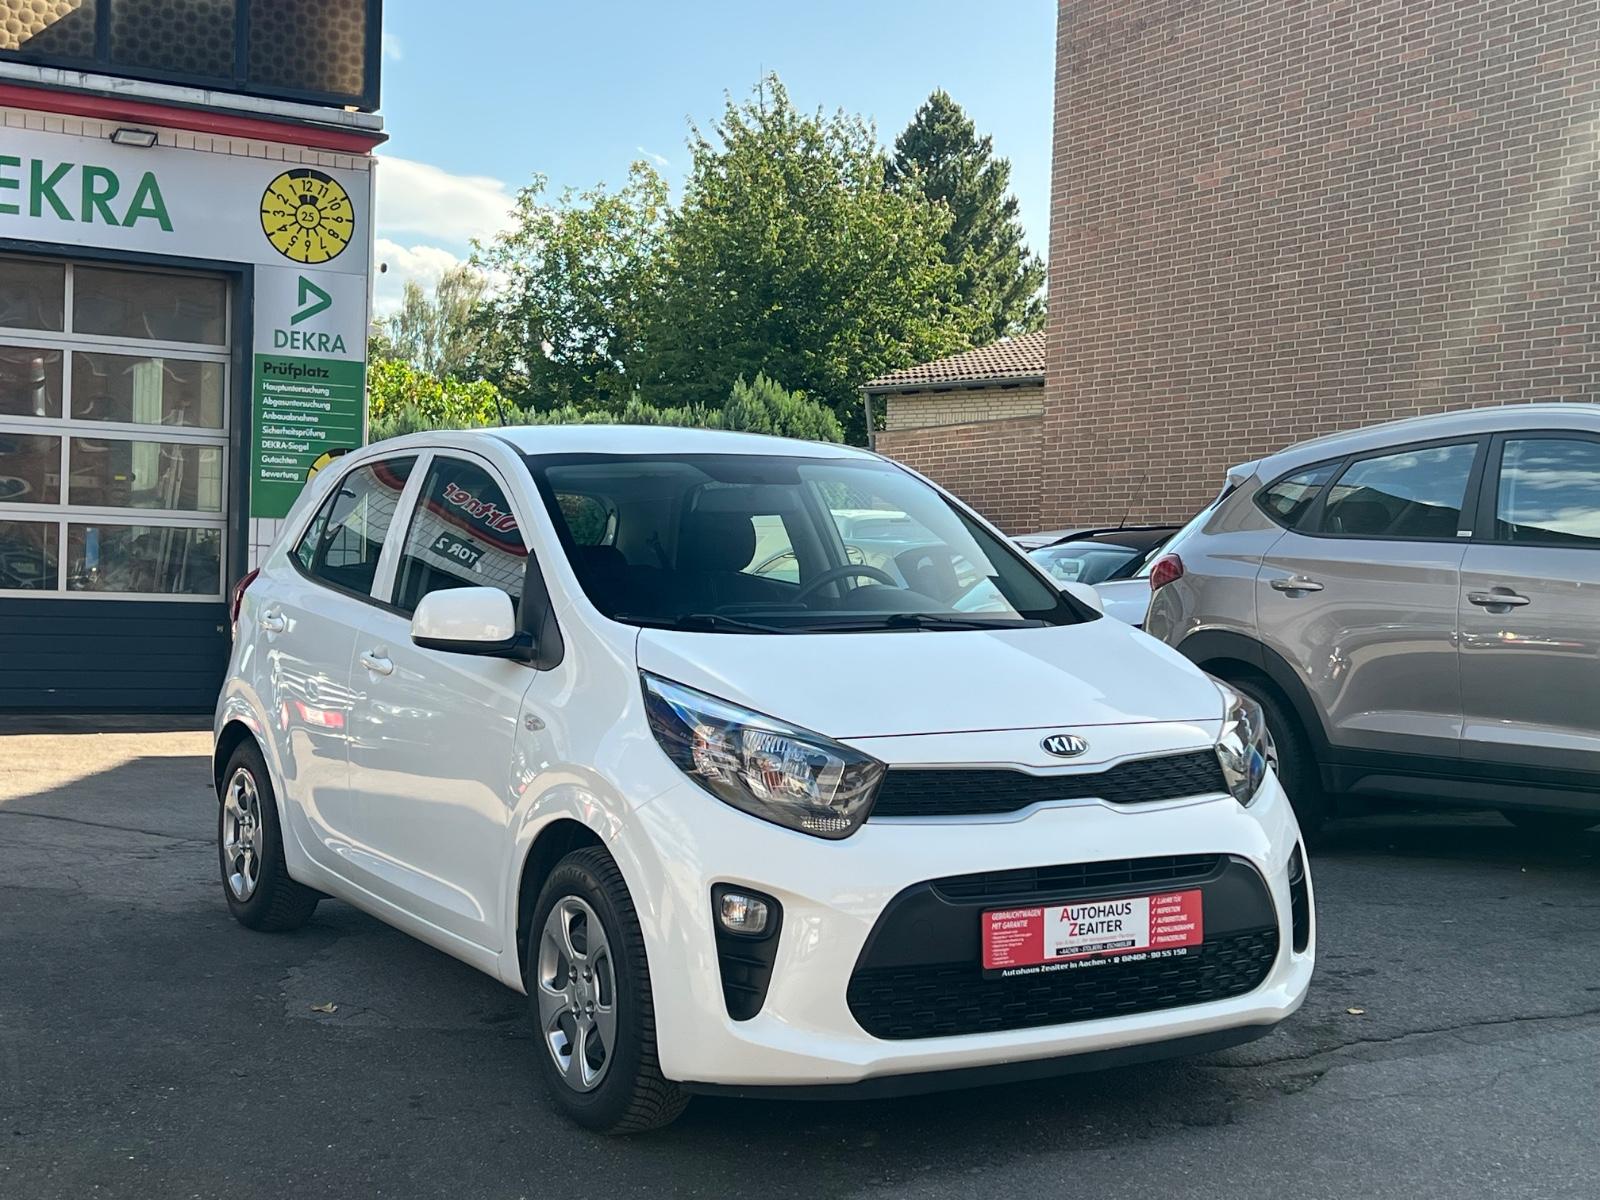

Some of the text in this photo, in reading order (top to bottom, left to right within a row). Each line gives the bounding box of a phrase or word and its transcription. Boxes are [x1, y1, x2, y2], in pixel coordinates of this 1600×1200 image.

[289, 184, 297, 196] 1
[302, 180, 313, 192] 12
[317, 184, 329, 198] 11
[276, 193, 289, 205] 2
[327, 197, 341, 211] 10
[301, 211, 314, 222] 25
[276, 224, 288, 232] 4
[327, 228, 339, 239] 8
[288, 235, 298, 247] 5
[304, 240, 311, 252] 6
[320, 236, 327, 250] 7
[274, 329, 346, 353] DEKRA
[263, 361, 329, 379] Prüfplatz
[262, 382, 330, 396] Hauptuntersuchung
[262, 396, 331, 411] Abgasuntersuchung
[262, 411, 319, 422] Anbauabnahme
[262, 426, 326, 439] Sicherheitsprüfung
[261, 440, 309, 452] DEKRA-Siegel
[261, 455, 298, 464] Gutachten
[261, 469, 299, 480] Bewertung
[1047, 736, 1084, 752] KIA
[992, 909, 1041, 920] GEBRAUCHTWAGEN
[1060, 902, 1132, 922] AUTOHAUS
[1002, 919, 1028, 930] GARANTIE
[1069, 919, 1122, 937] ZEAITER
[1001, 967, 1040, 977] Autohaus
[1041, 962, 1069, 972] Zeaiter
[1078, 957, 1106, 968] Aachen
